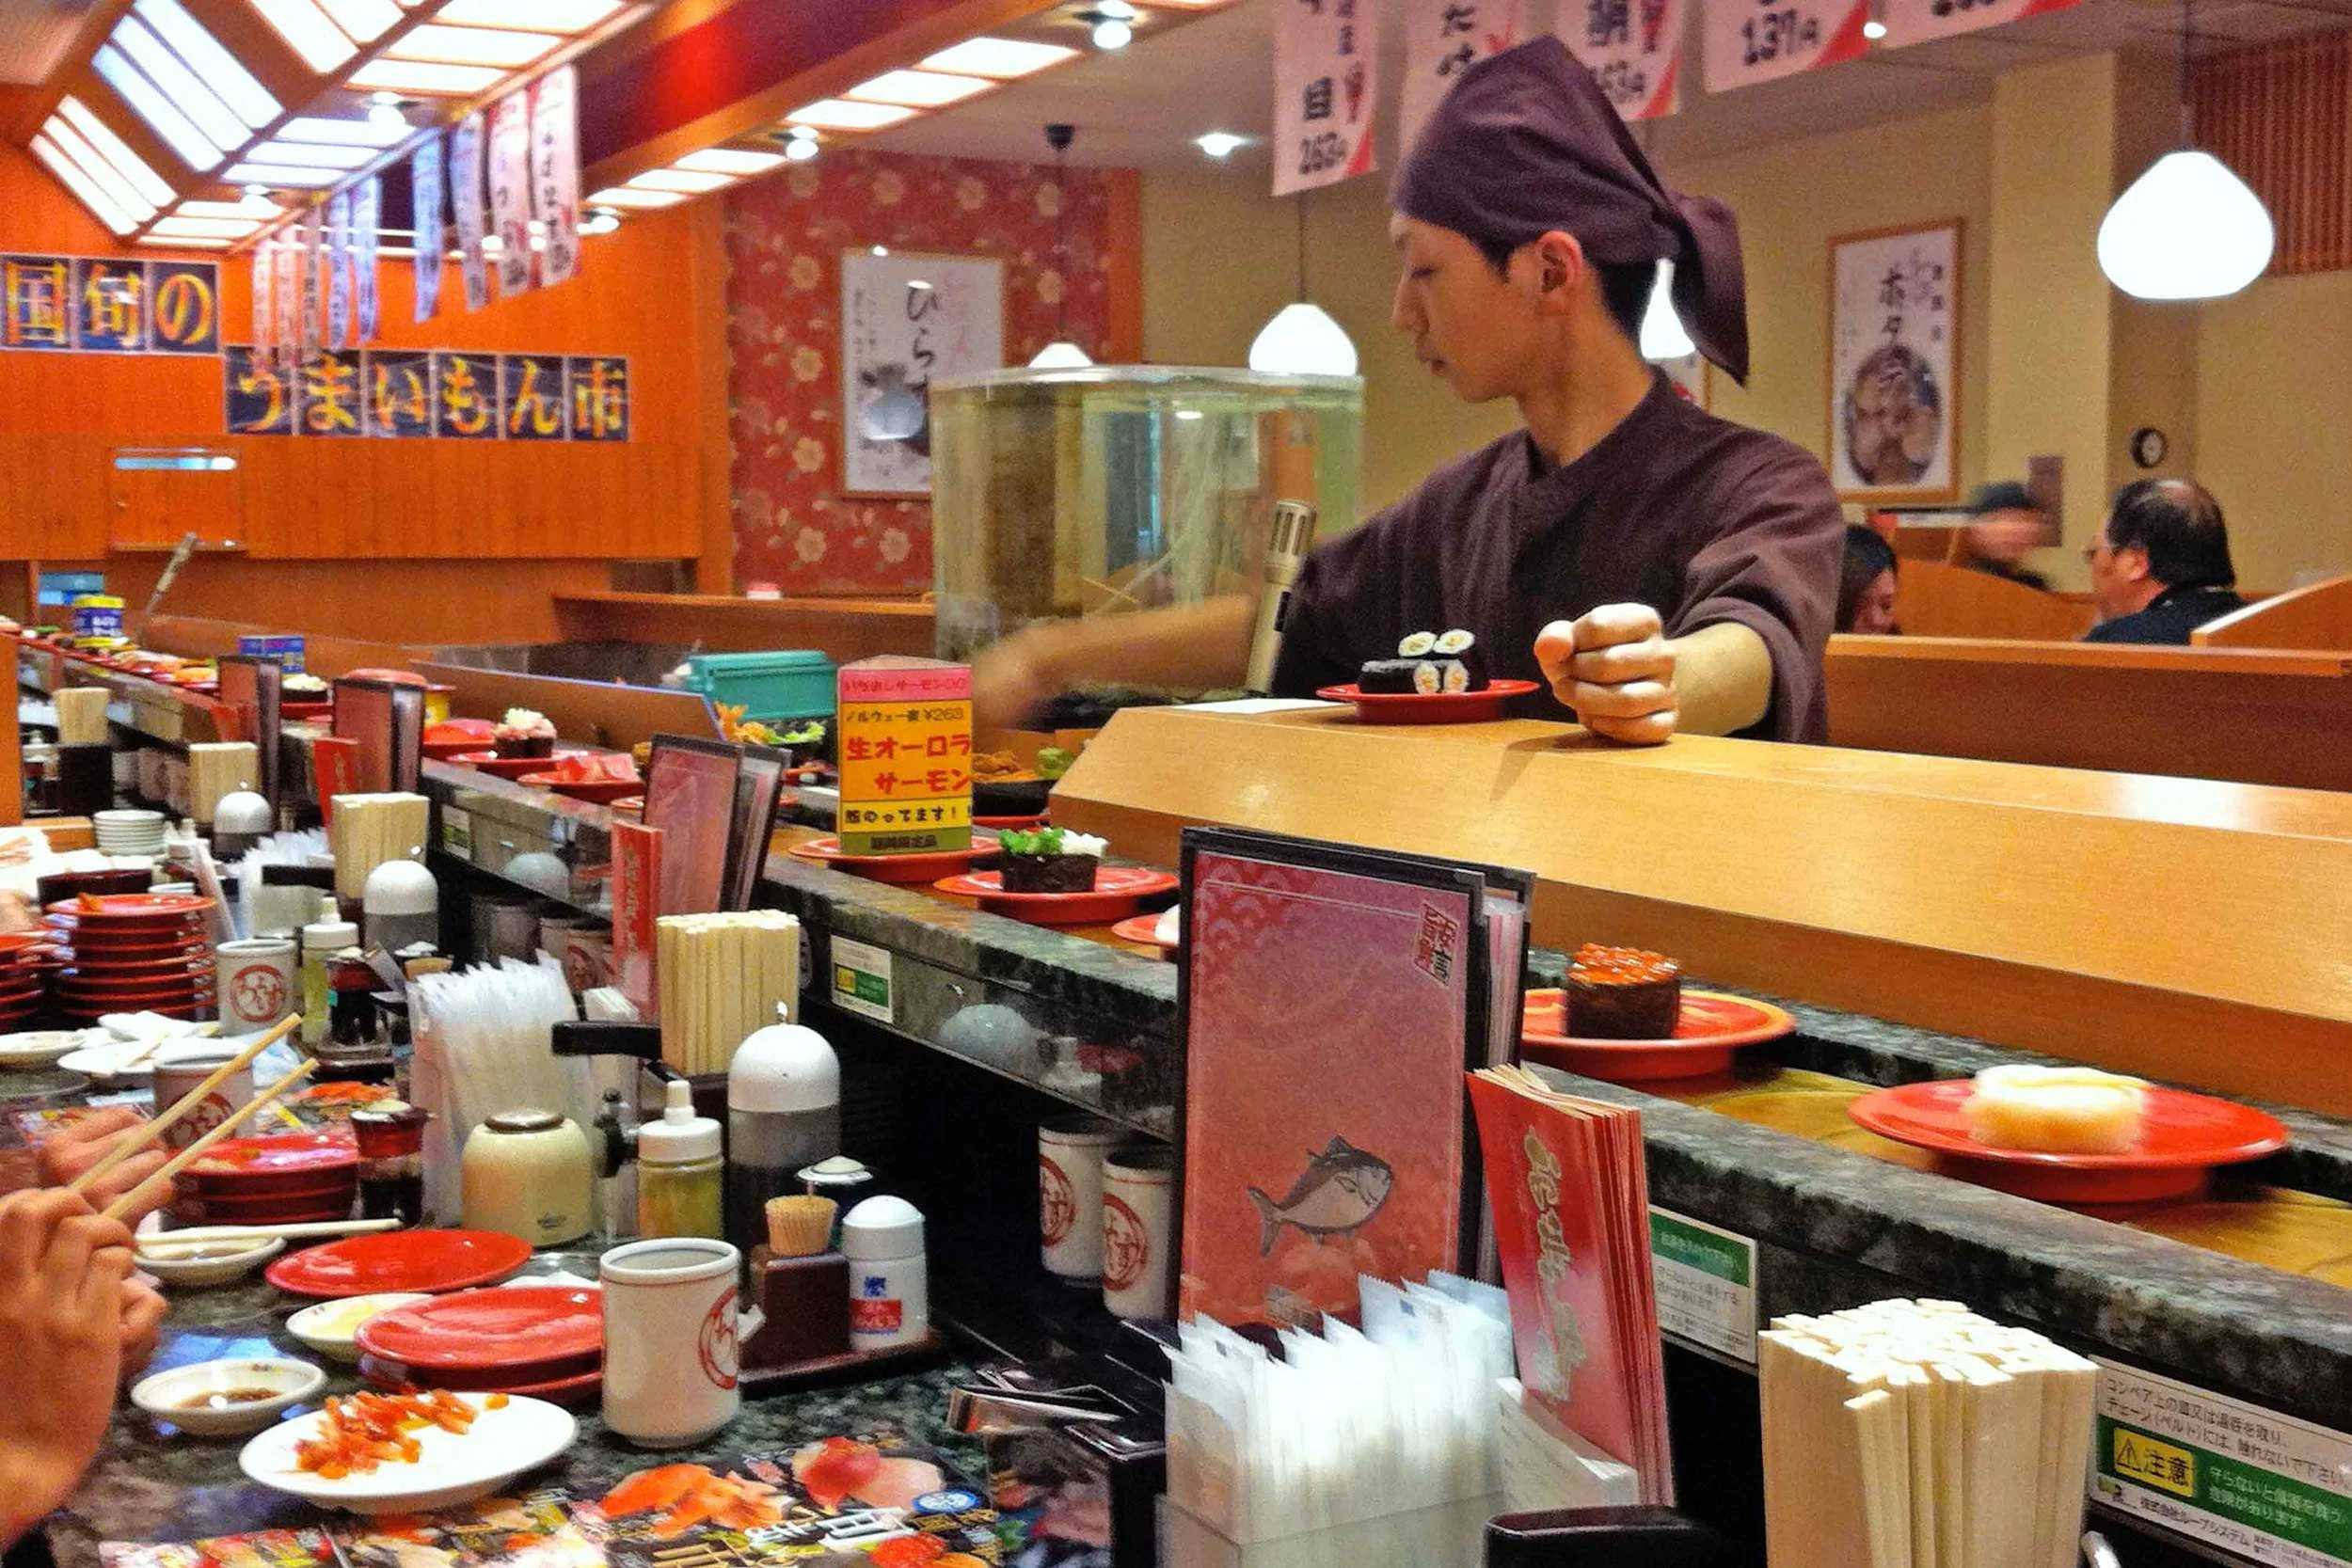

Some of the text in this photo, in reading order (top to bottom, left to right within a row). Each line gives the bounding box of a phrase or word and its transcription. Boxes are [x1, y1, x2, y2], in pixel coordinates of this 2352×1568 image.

[237, 352, 626, 436] うまいもん市
[847, 734, 971, 761] 生オーロラ
[875, 768, 971, 795] サーモン
[2145, 1448, 2191, 1488] 注意
